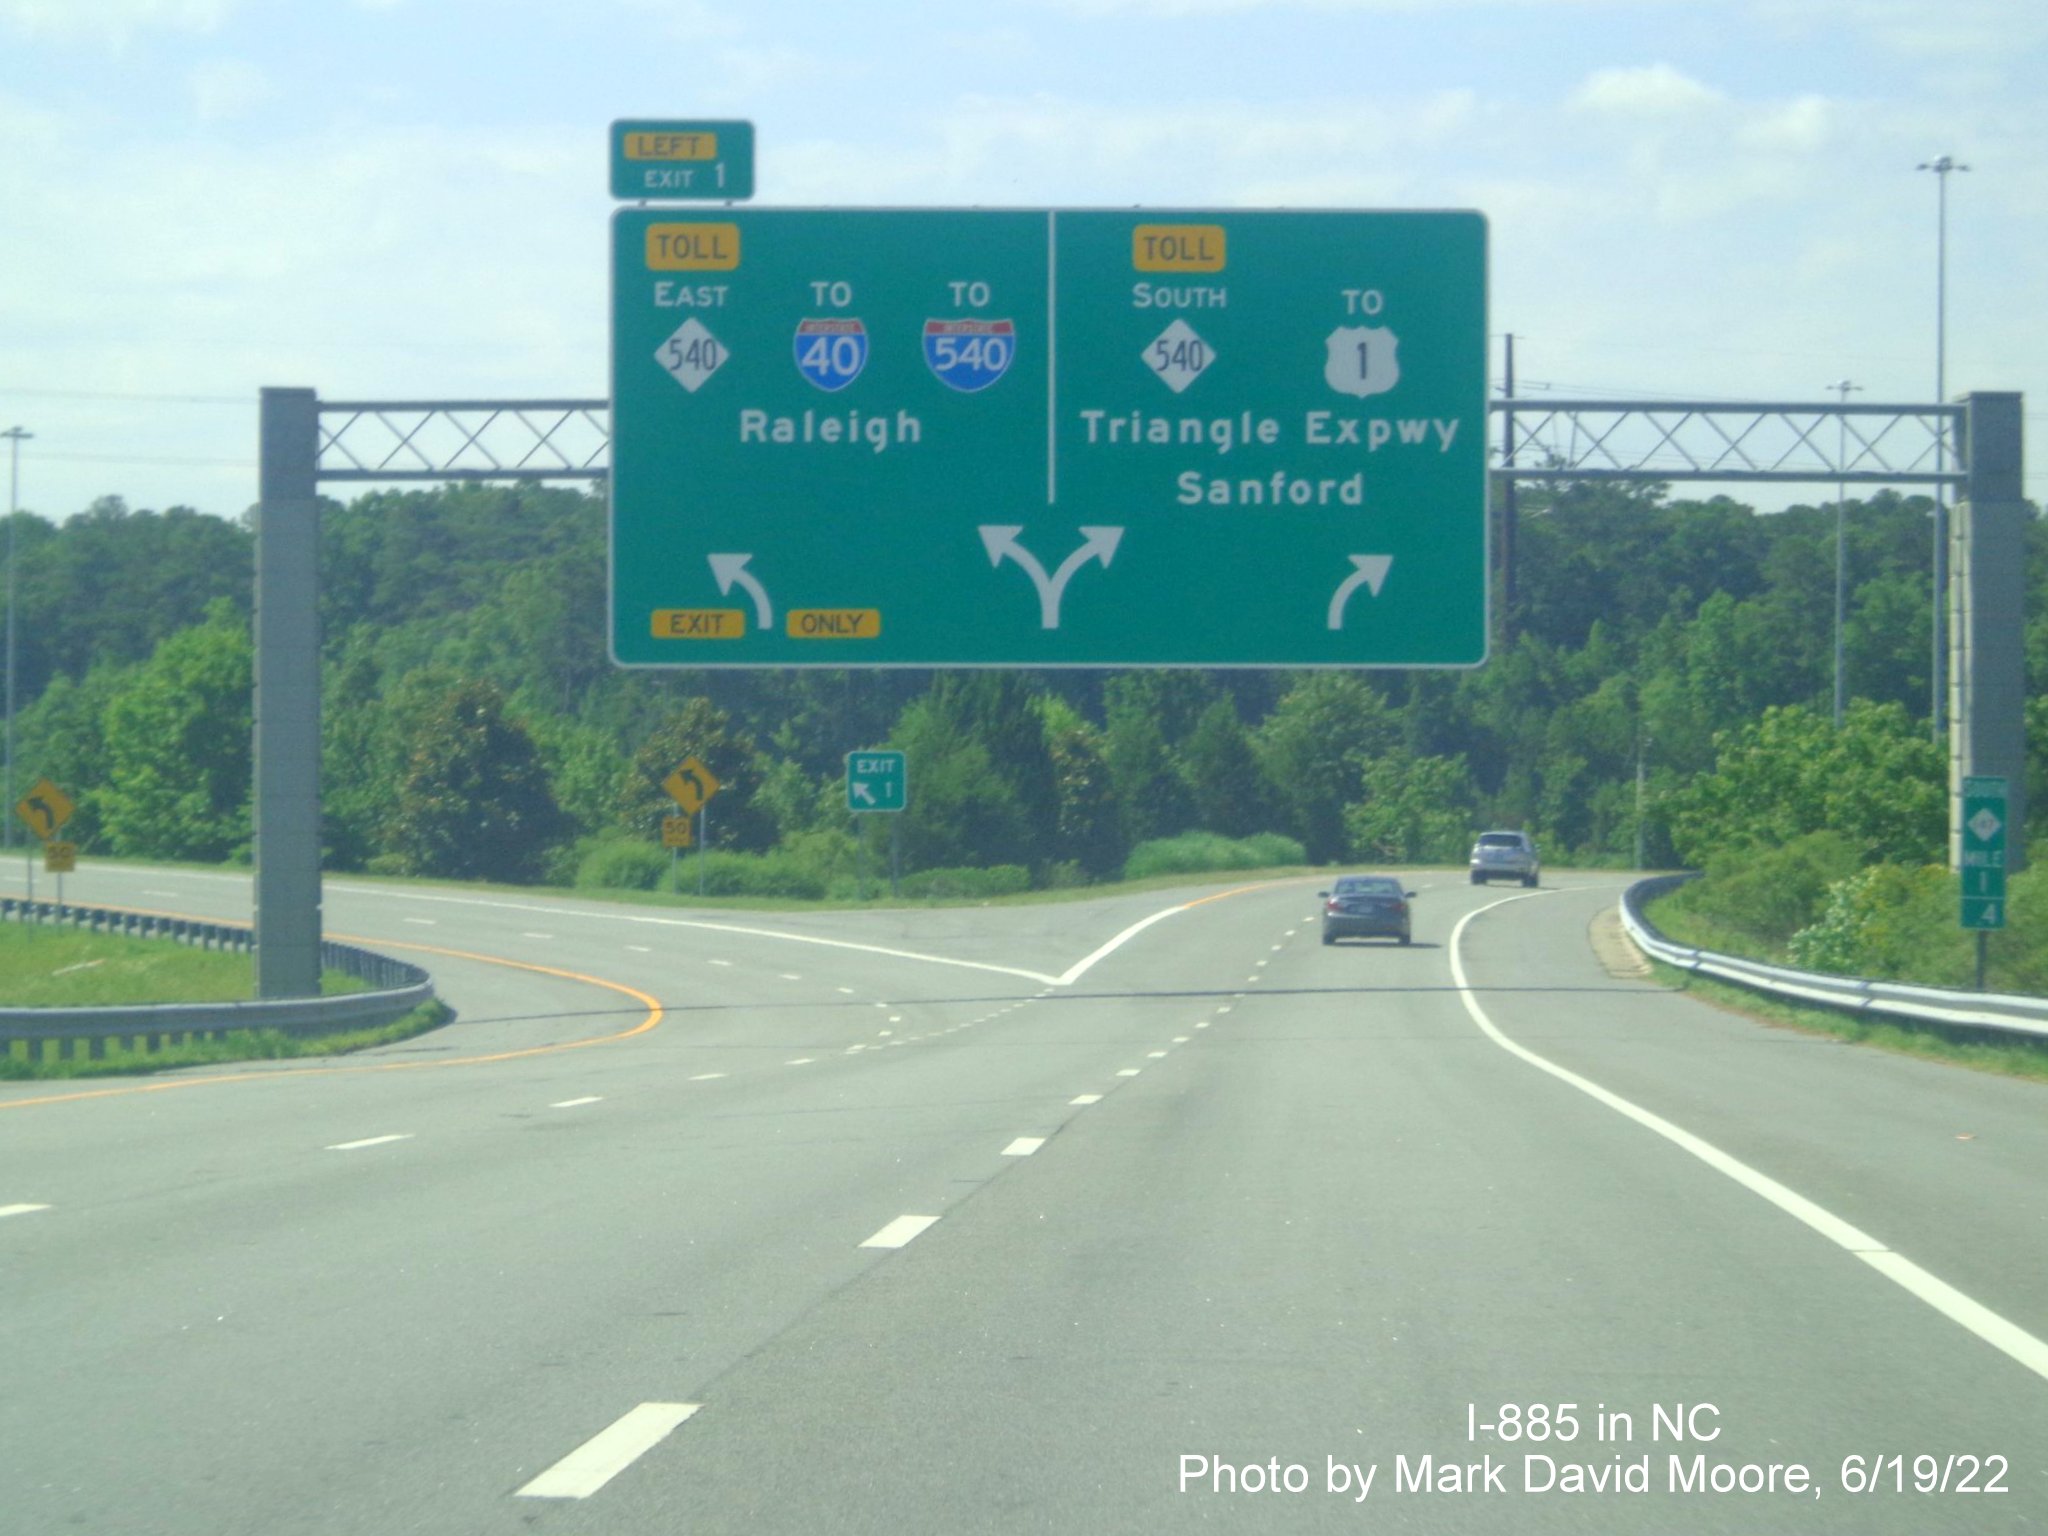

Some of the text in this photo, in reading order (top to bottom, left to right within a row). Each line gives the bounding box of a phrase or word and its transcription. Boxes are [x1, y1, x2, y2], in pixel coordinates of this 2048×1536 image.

[638, 137, 700, 156] LEFT
[644, 163, 726, 188] EXIT 1
[657, 234, 728, 259] TOLL
[1143, 235, 1215, 260] TOLL
[810, 281, 852, 307] TO
[948, 281, 991, 307] TO
[1342, 289, 1385, 315] TO
[668, 338, 718, 371] 540
[802, 336, 861, 376] 40
[935, 337, 1008, 372] 540
[1156, 339, 1204, 372] 540
[1356, 342, 1367, 380] 1
[740, 408, 921, 454] Raleigh
[1080, 410, 1460, 454] Triangle Expwy
[1177, 471, 1364, 505] Sanford
[669, 613, 864, 634] EXIT ONLY
[857, 759, 895, 774] EXIT
[885, 781, 892, 798] 1
[1981, 903, 1996, 925] 4
